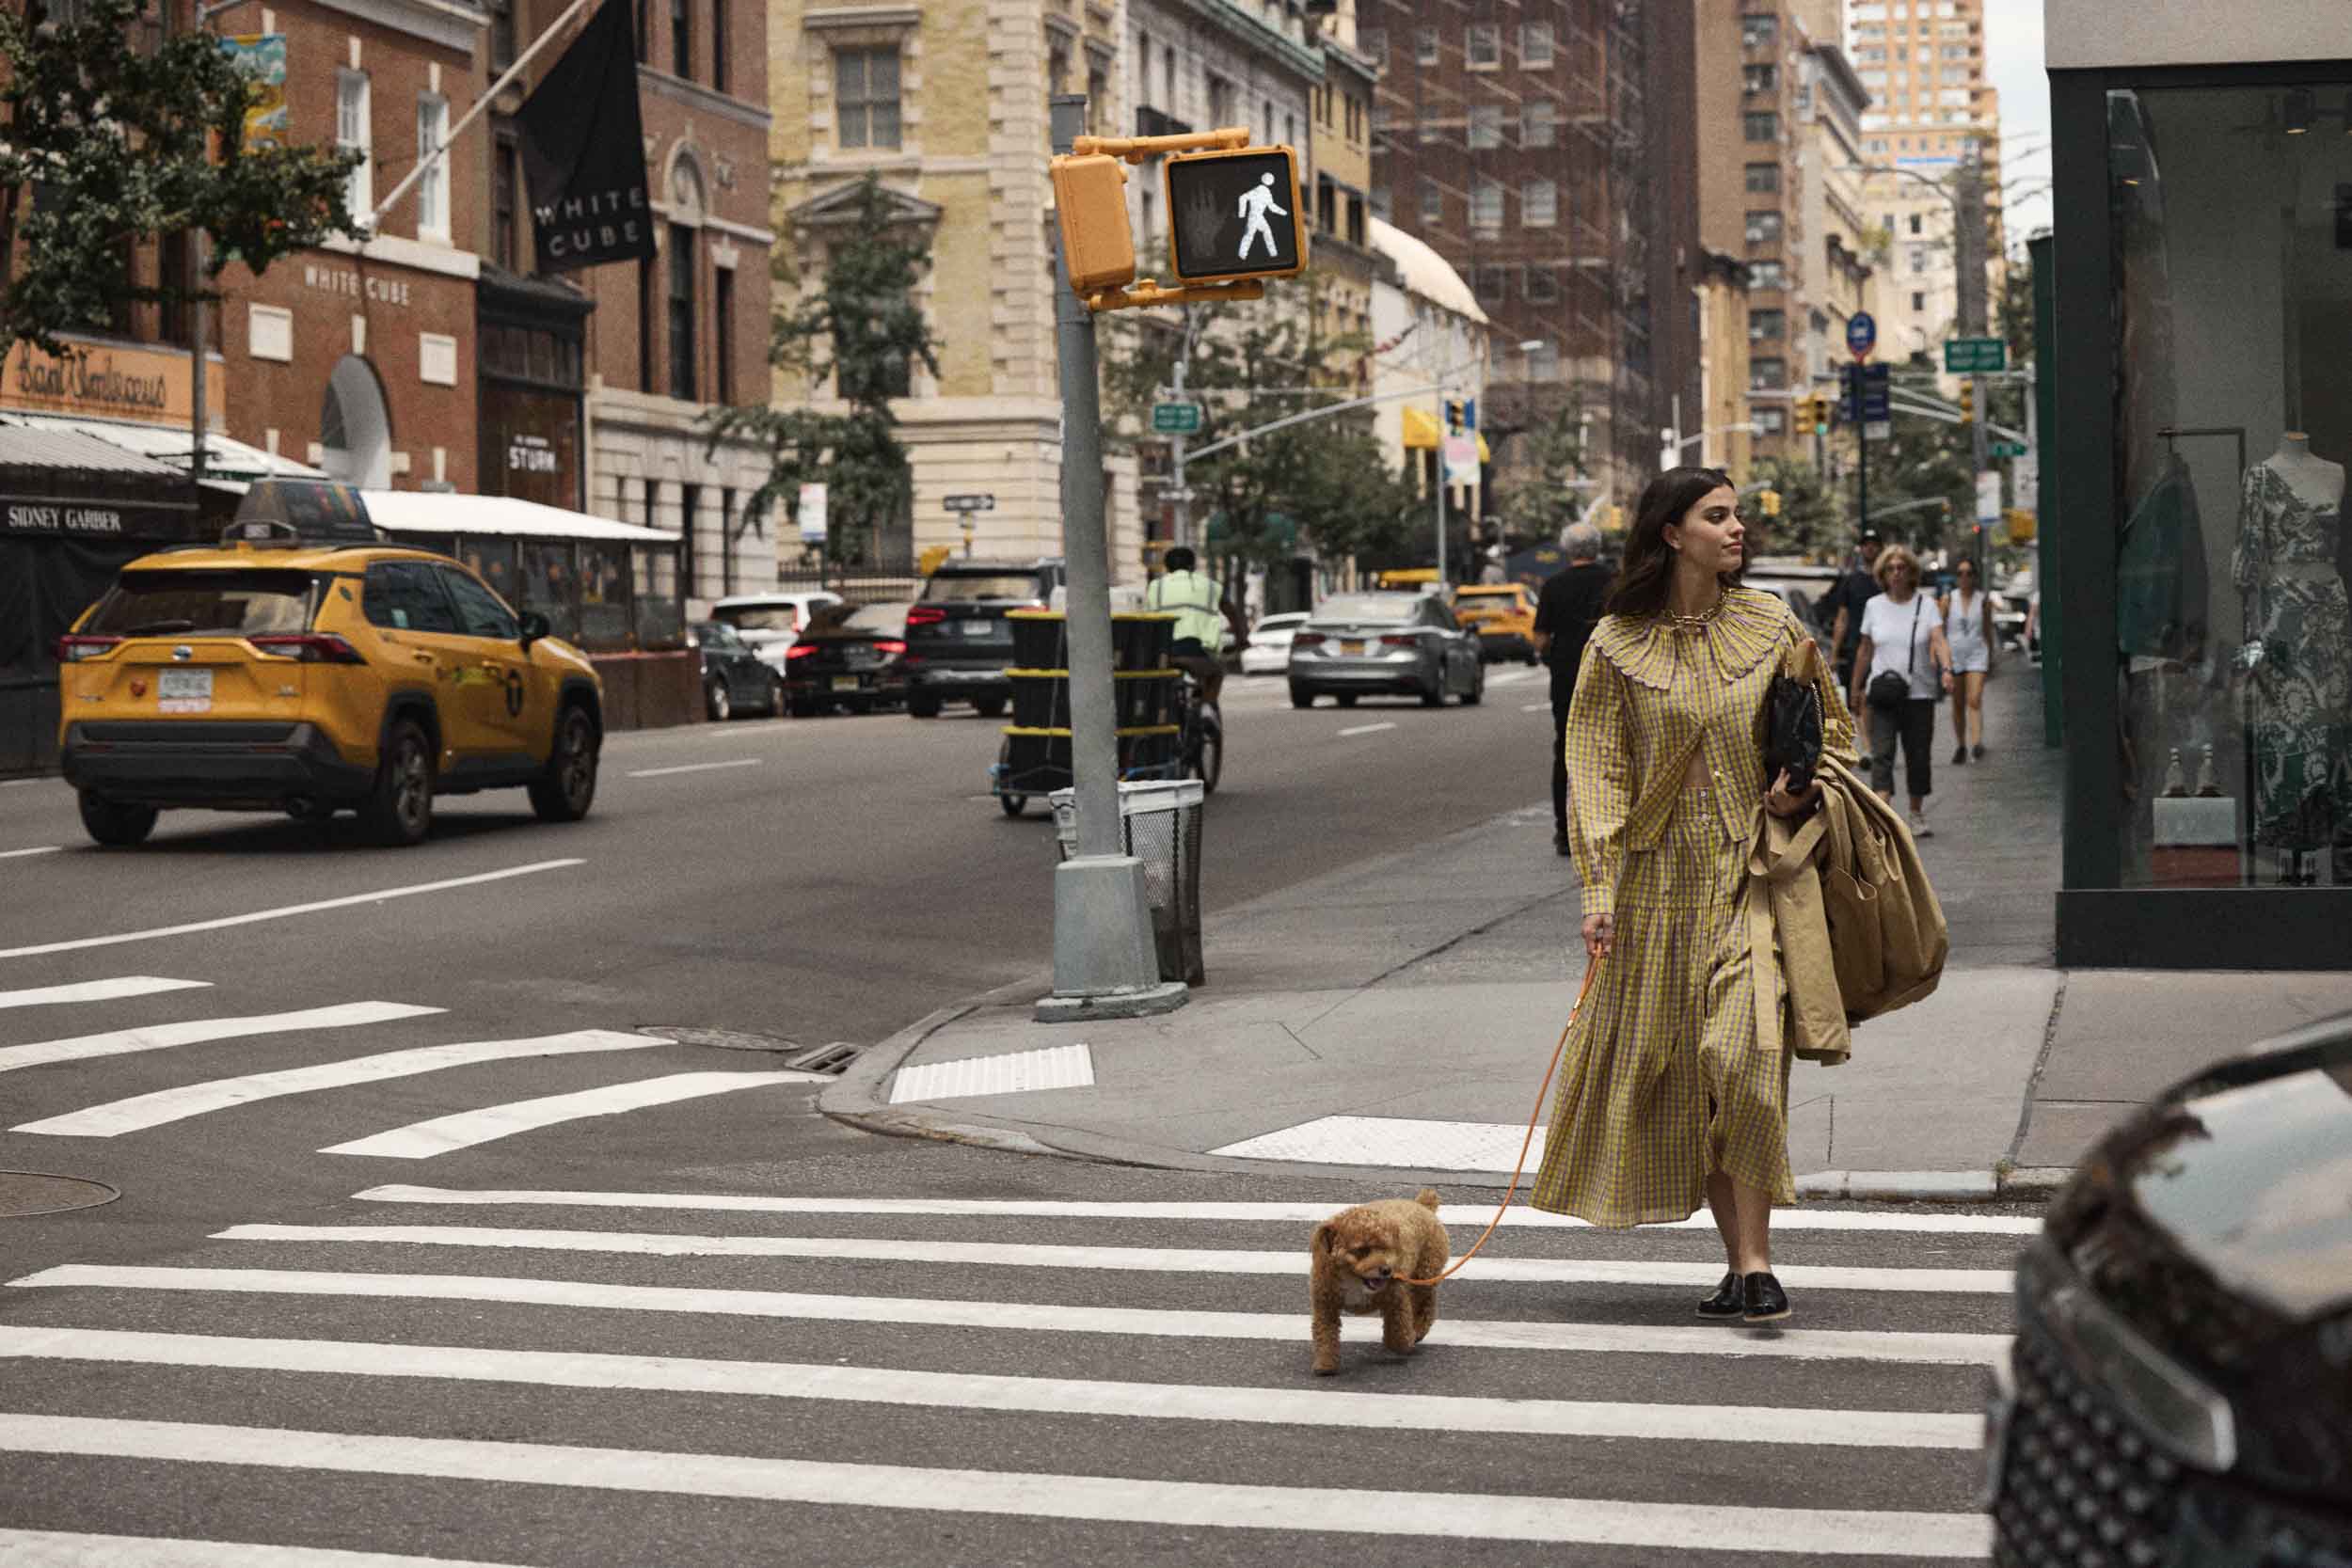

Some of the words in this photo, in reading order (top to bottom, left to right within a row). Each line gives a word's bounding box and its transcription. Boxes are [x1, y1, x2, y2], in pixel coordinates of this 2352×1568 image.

[534, 187, 643, 225] WHITE
[548, 219, 639, 257] CUBE
[305, 266, 358, 296] WHITE
[365, 276, 408, 306] CUBE
[8, 506, 58, 528] SIDNEY
[65, 509, 120, 531] GARBER
